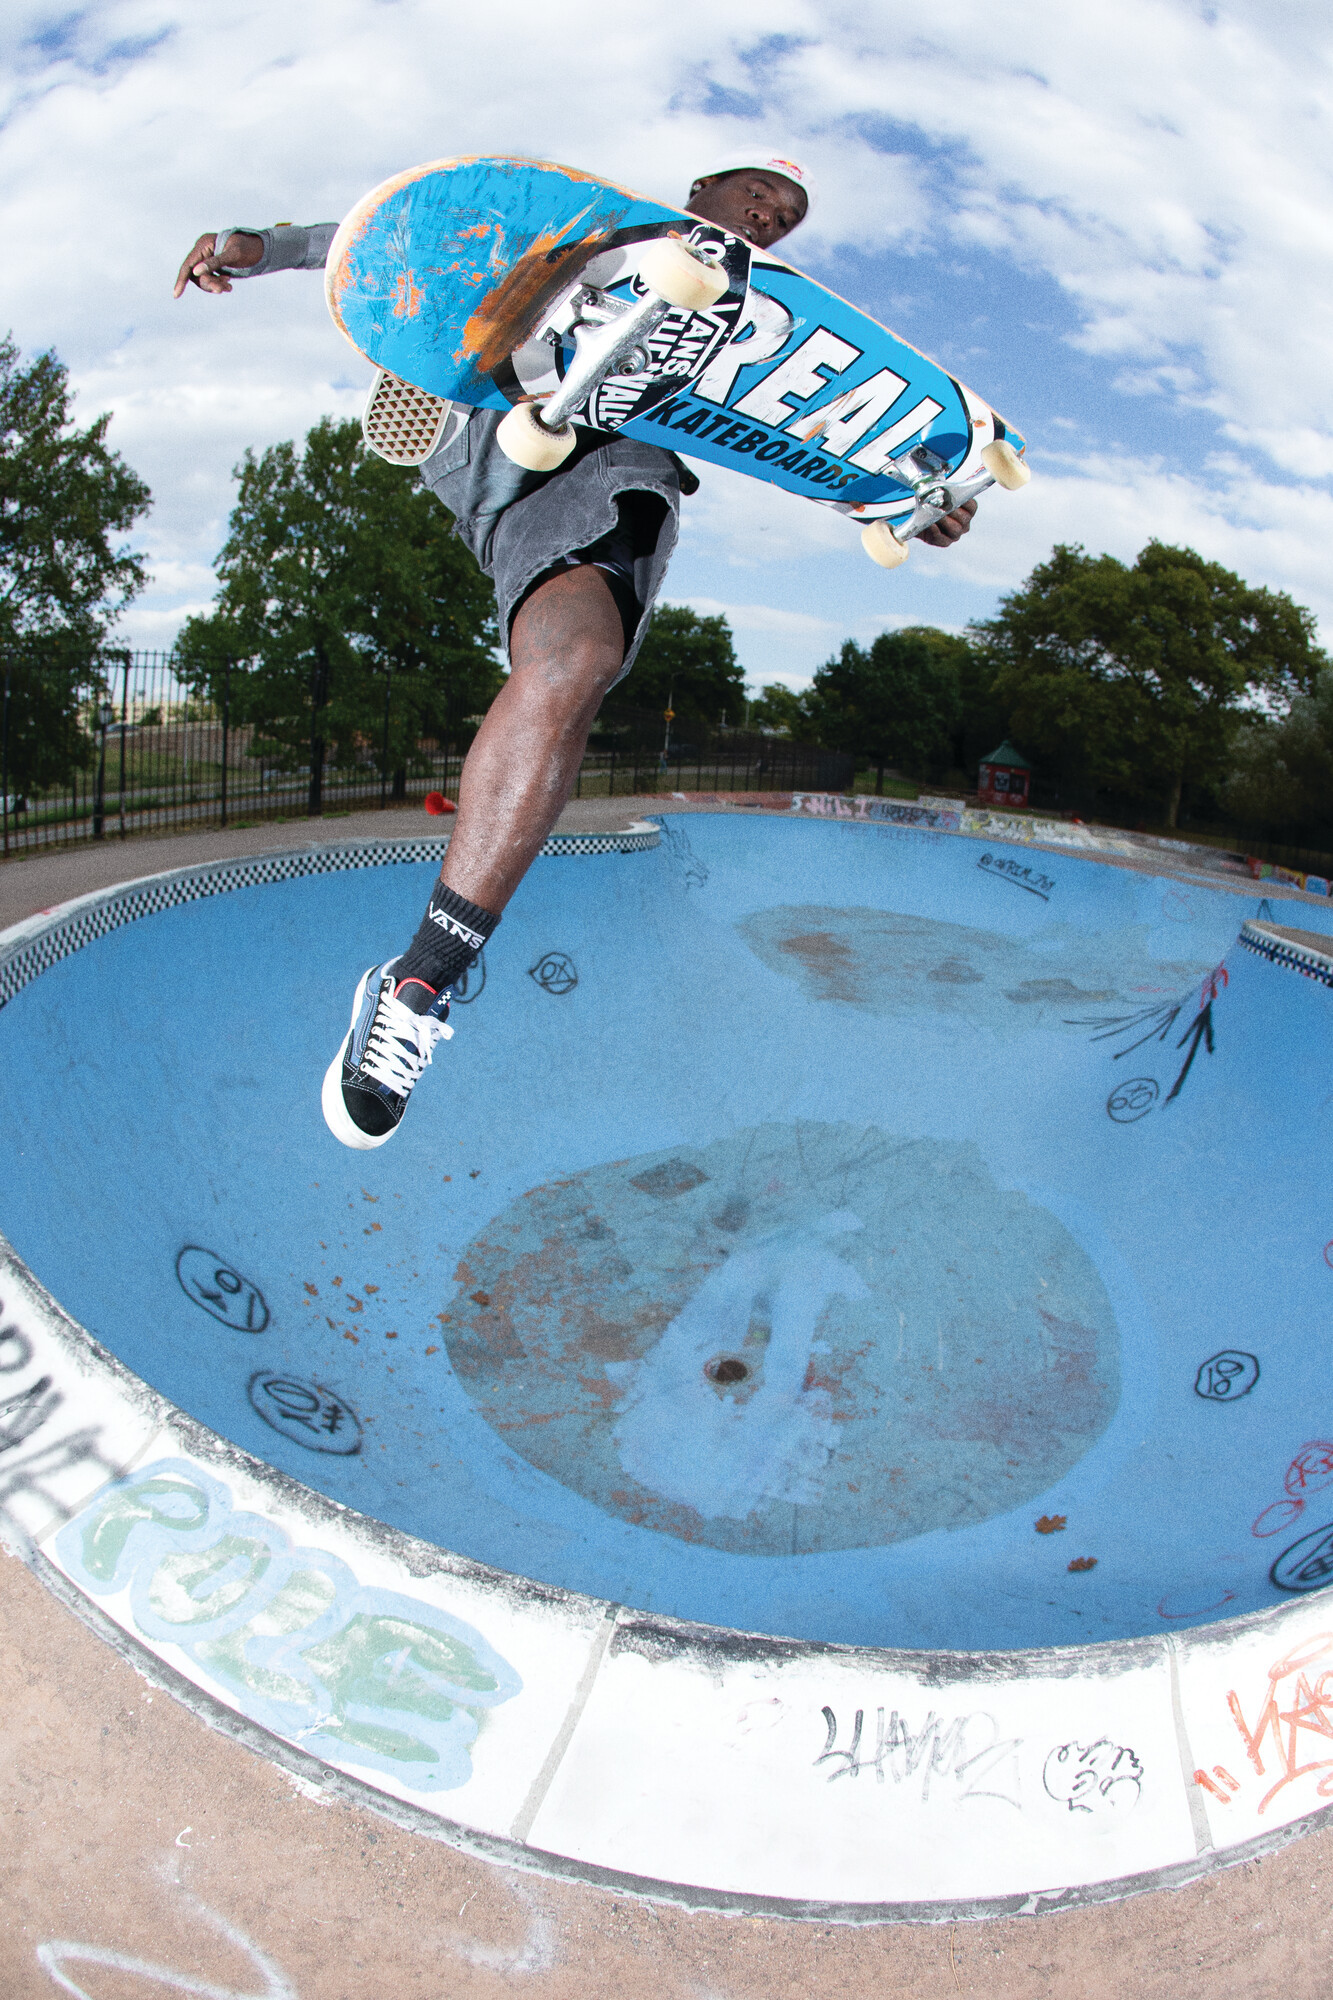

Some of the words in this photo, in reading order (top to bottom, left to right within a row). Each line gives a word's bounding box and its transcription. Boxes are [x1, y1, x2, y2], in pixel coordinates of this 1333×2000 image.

[660, 302, 741, 379] VANS
[690, 284, 946, 477] REAL
[644, 397, 860, 490] KATEBOARDS
[429, 901, 486, 949] VANS
